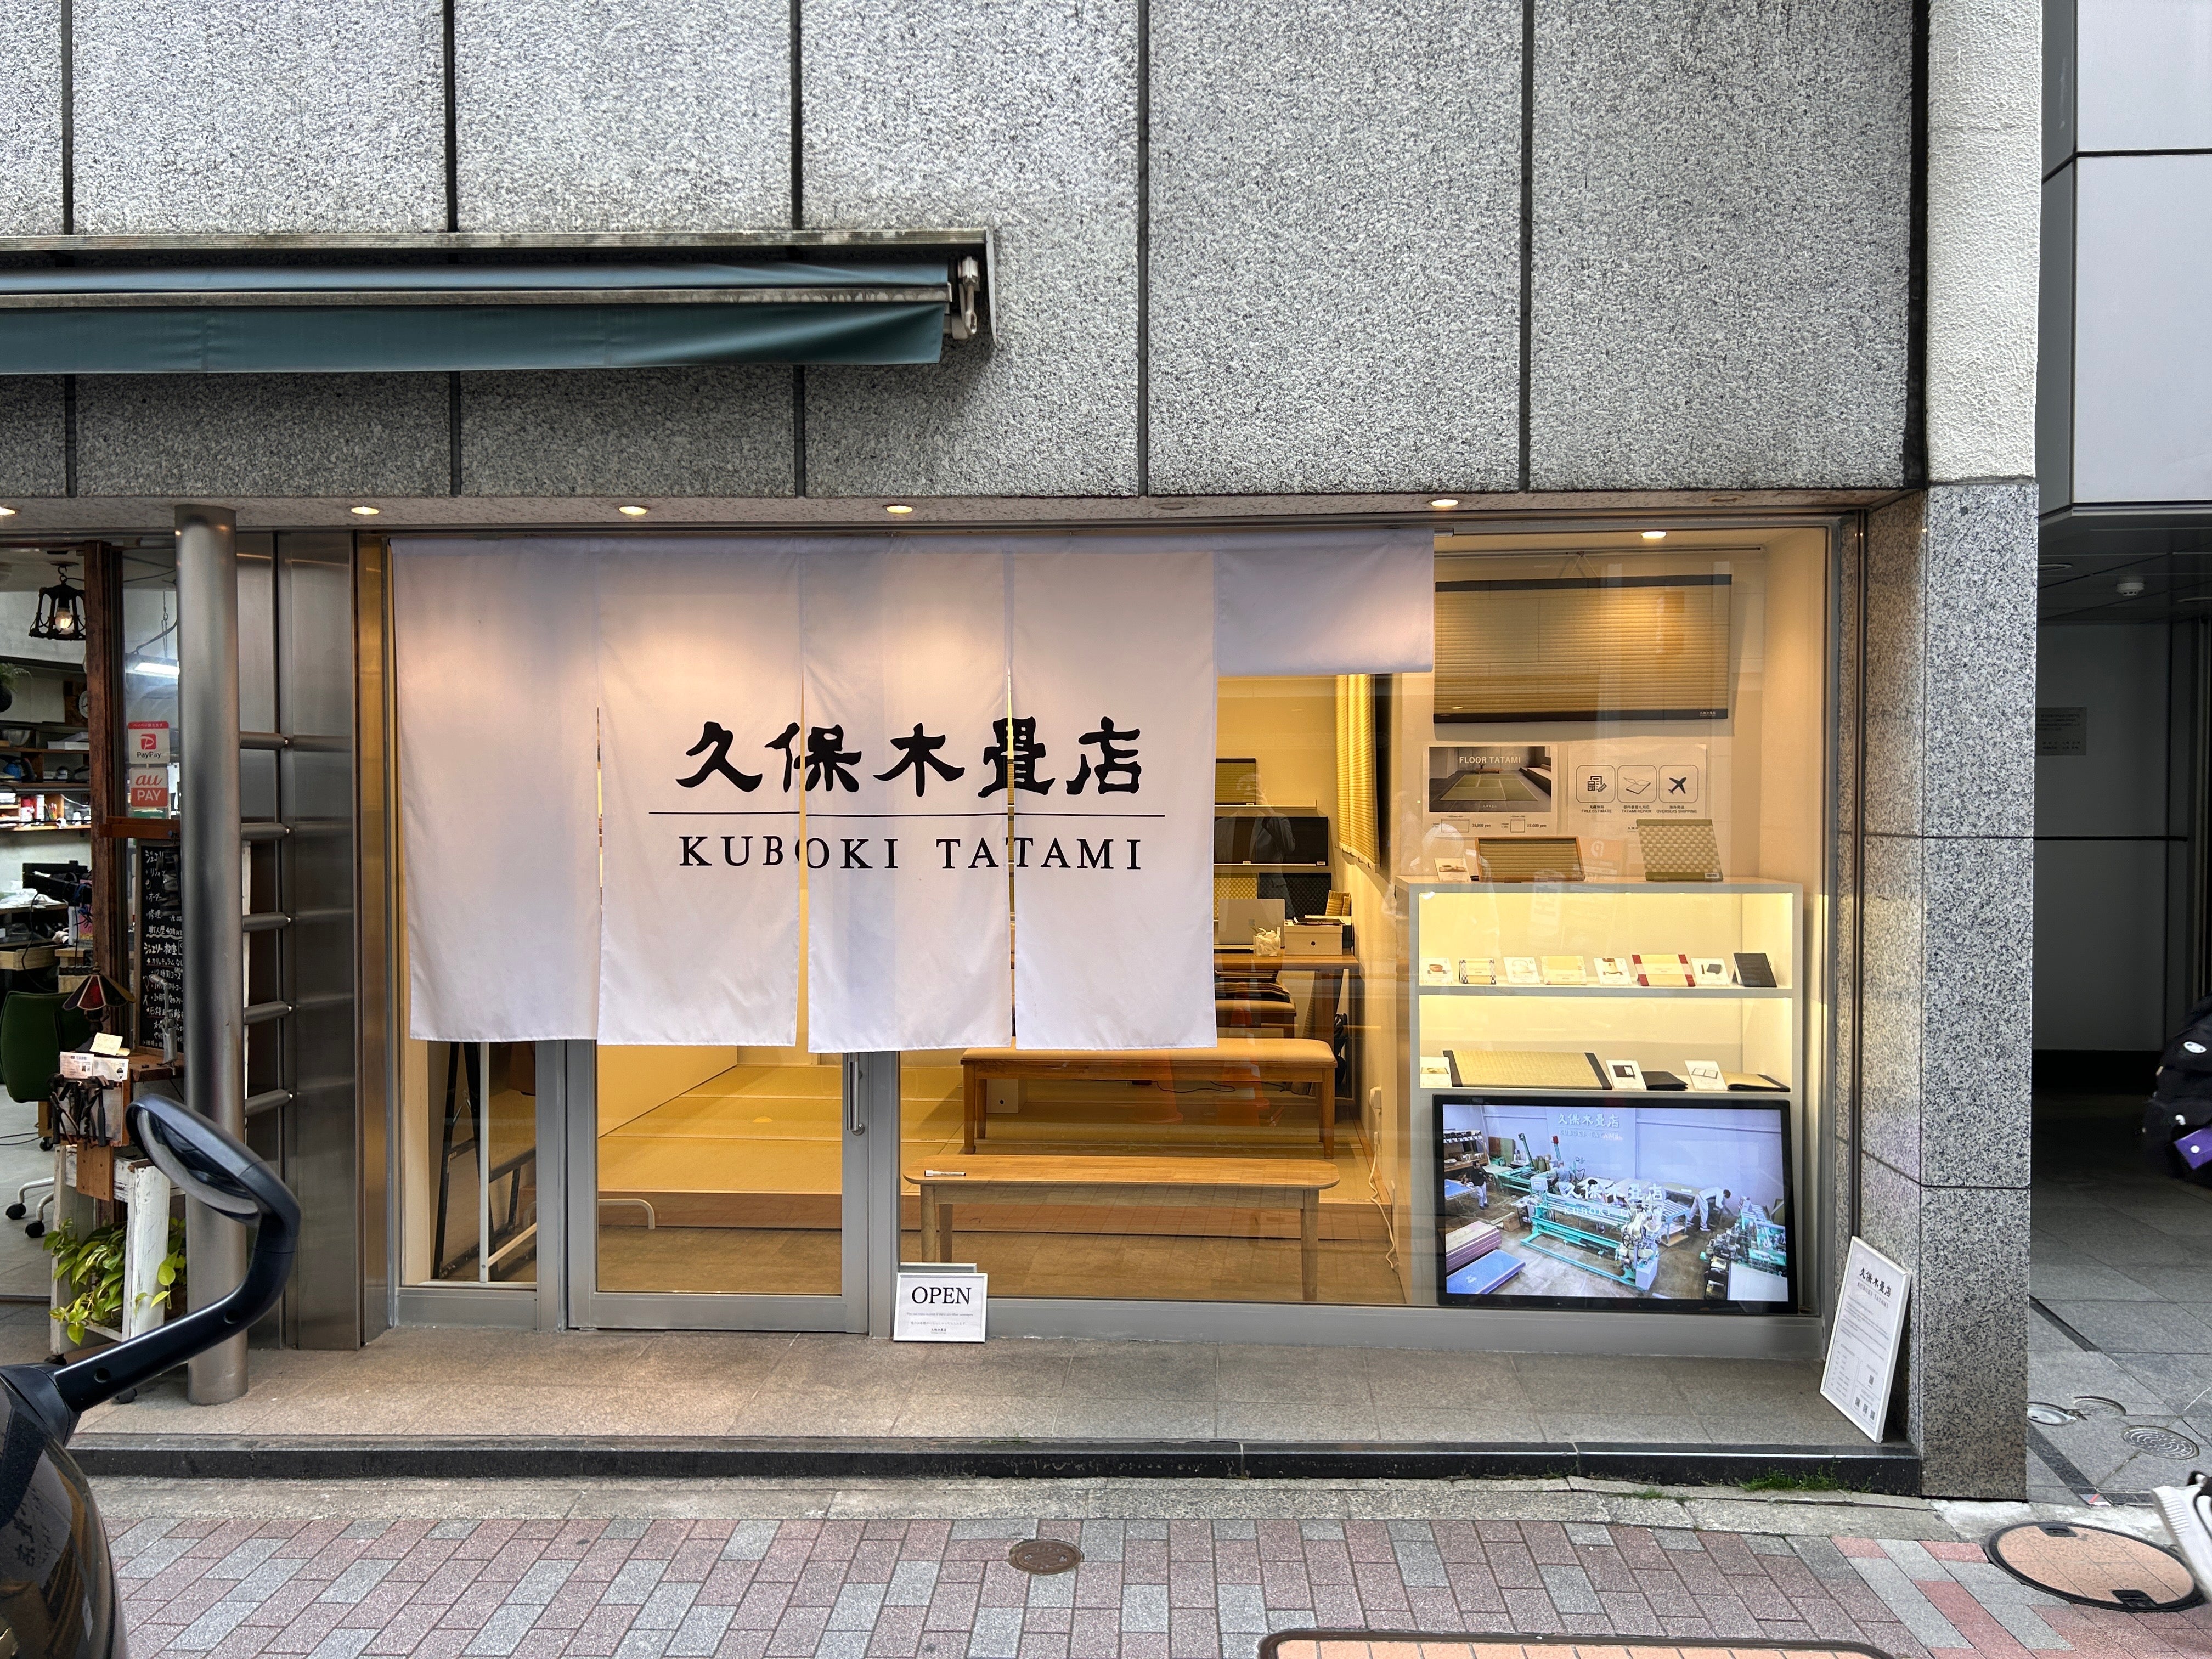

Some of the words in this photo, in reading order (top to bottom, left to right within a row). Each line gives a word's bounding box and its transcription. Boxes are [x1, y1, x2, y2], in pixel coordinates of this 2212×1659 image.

[676, 716, 1142, 798] 久保木畳店
[135, 775, 163, 786] au
[137, 789, 161, 801] PAY
[679, 836, 899, 870] KUBOKI
[936, 837, 1142, 870] TATAMI
[1558, 1113, 1620, 1127] 久保木畳店
[912, 1286, 972, 1305] OPEN
